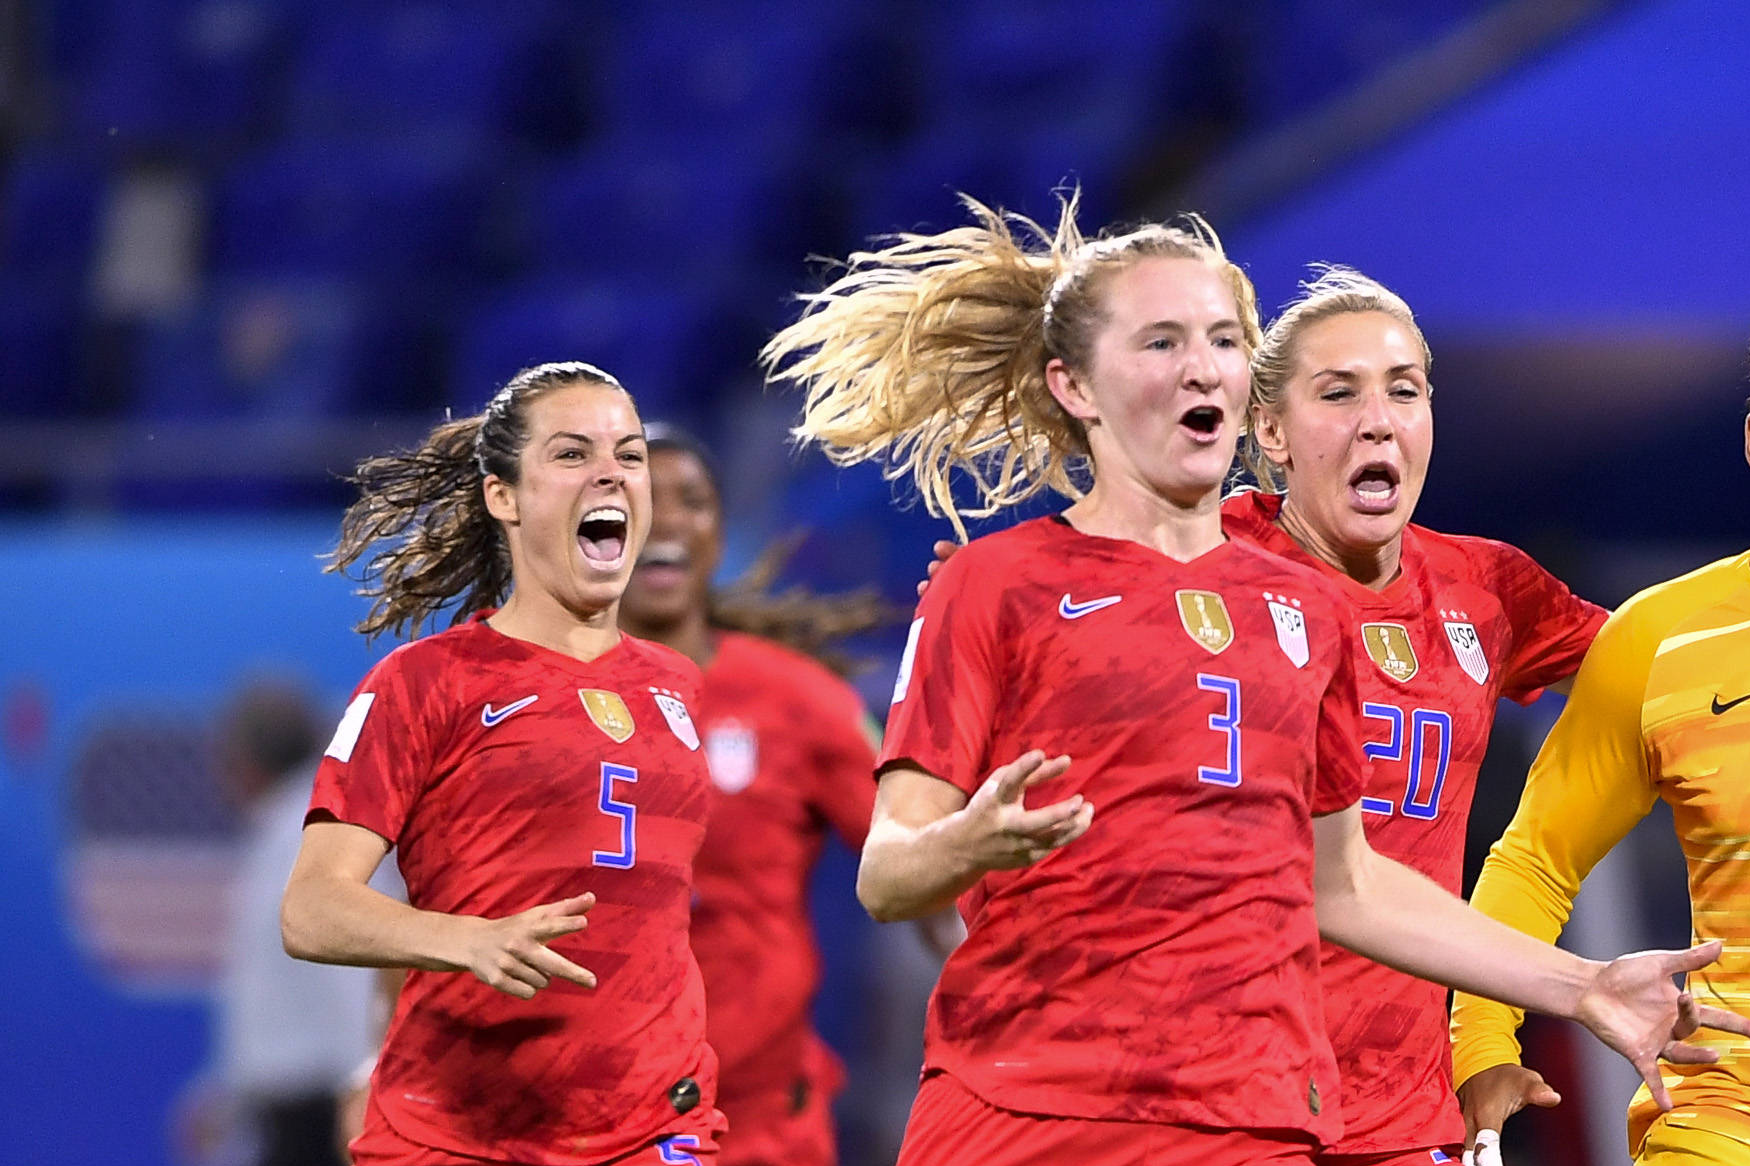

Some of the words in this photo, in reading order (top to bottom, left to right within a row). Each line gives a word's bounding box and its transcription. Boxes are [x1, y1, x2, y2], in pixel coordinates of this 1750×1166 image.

[1448, 626, 1476, 649] USA
[1196, 672, 1242, 787] 3
[1360, 701, 1453, 821] 20
[592, 761, 638, 870] 5
